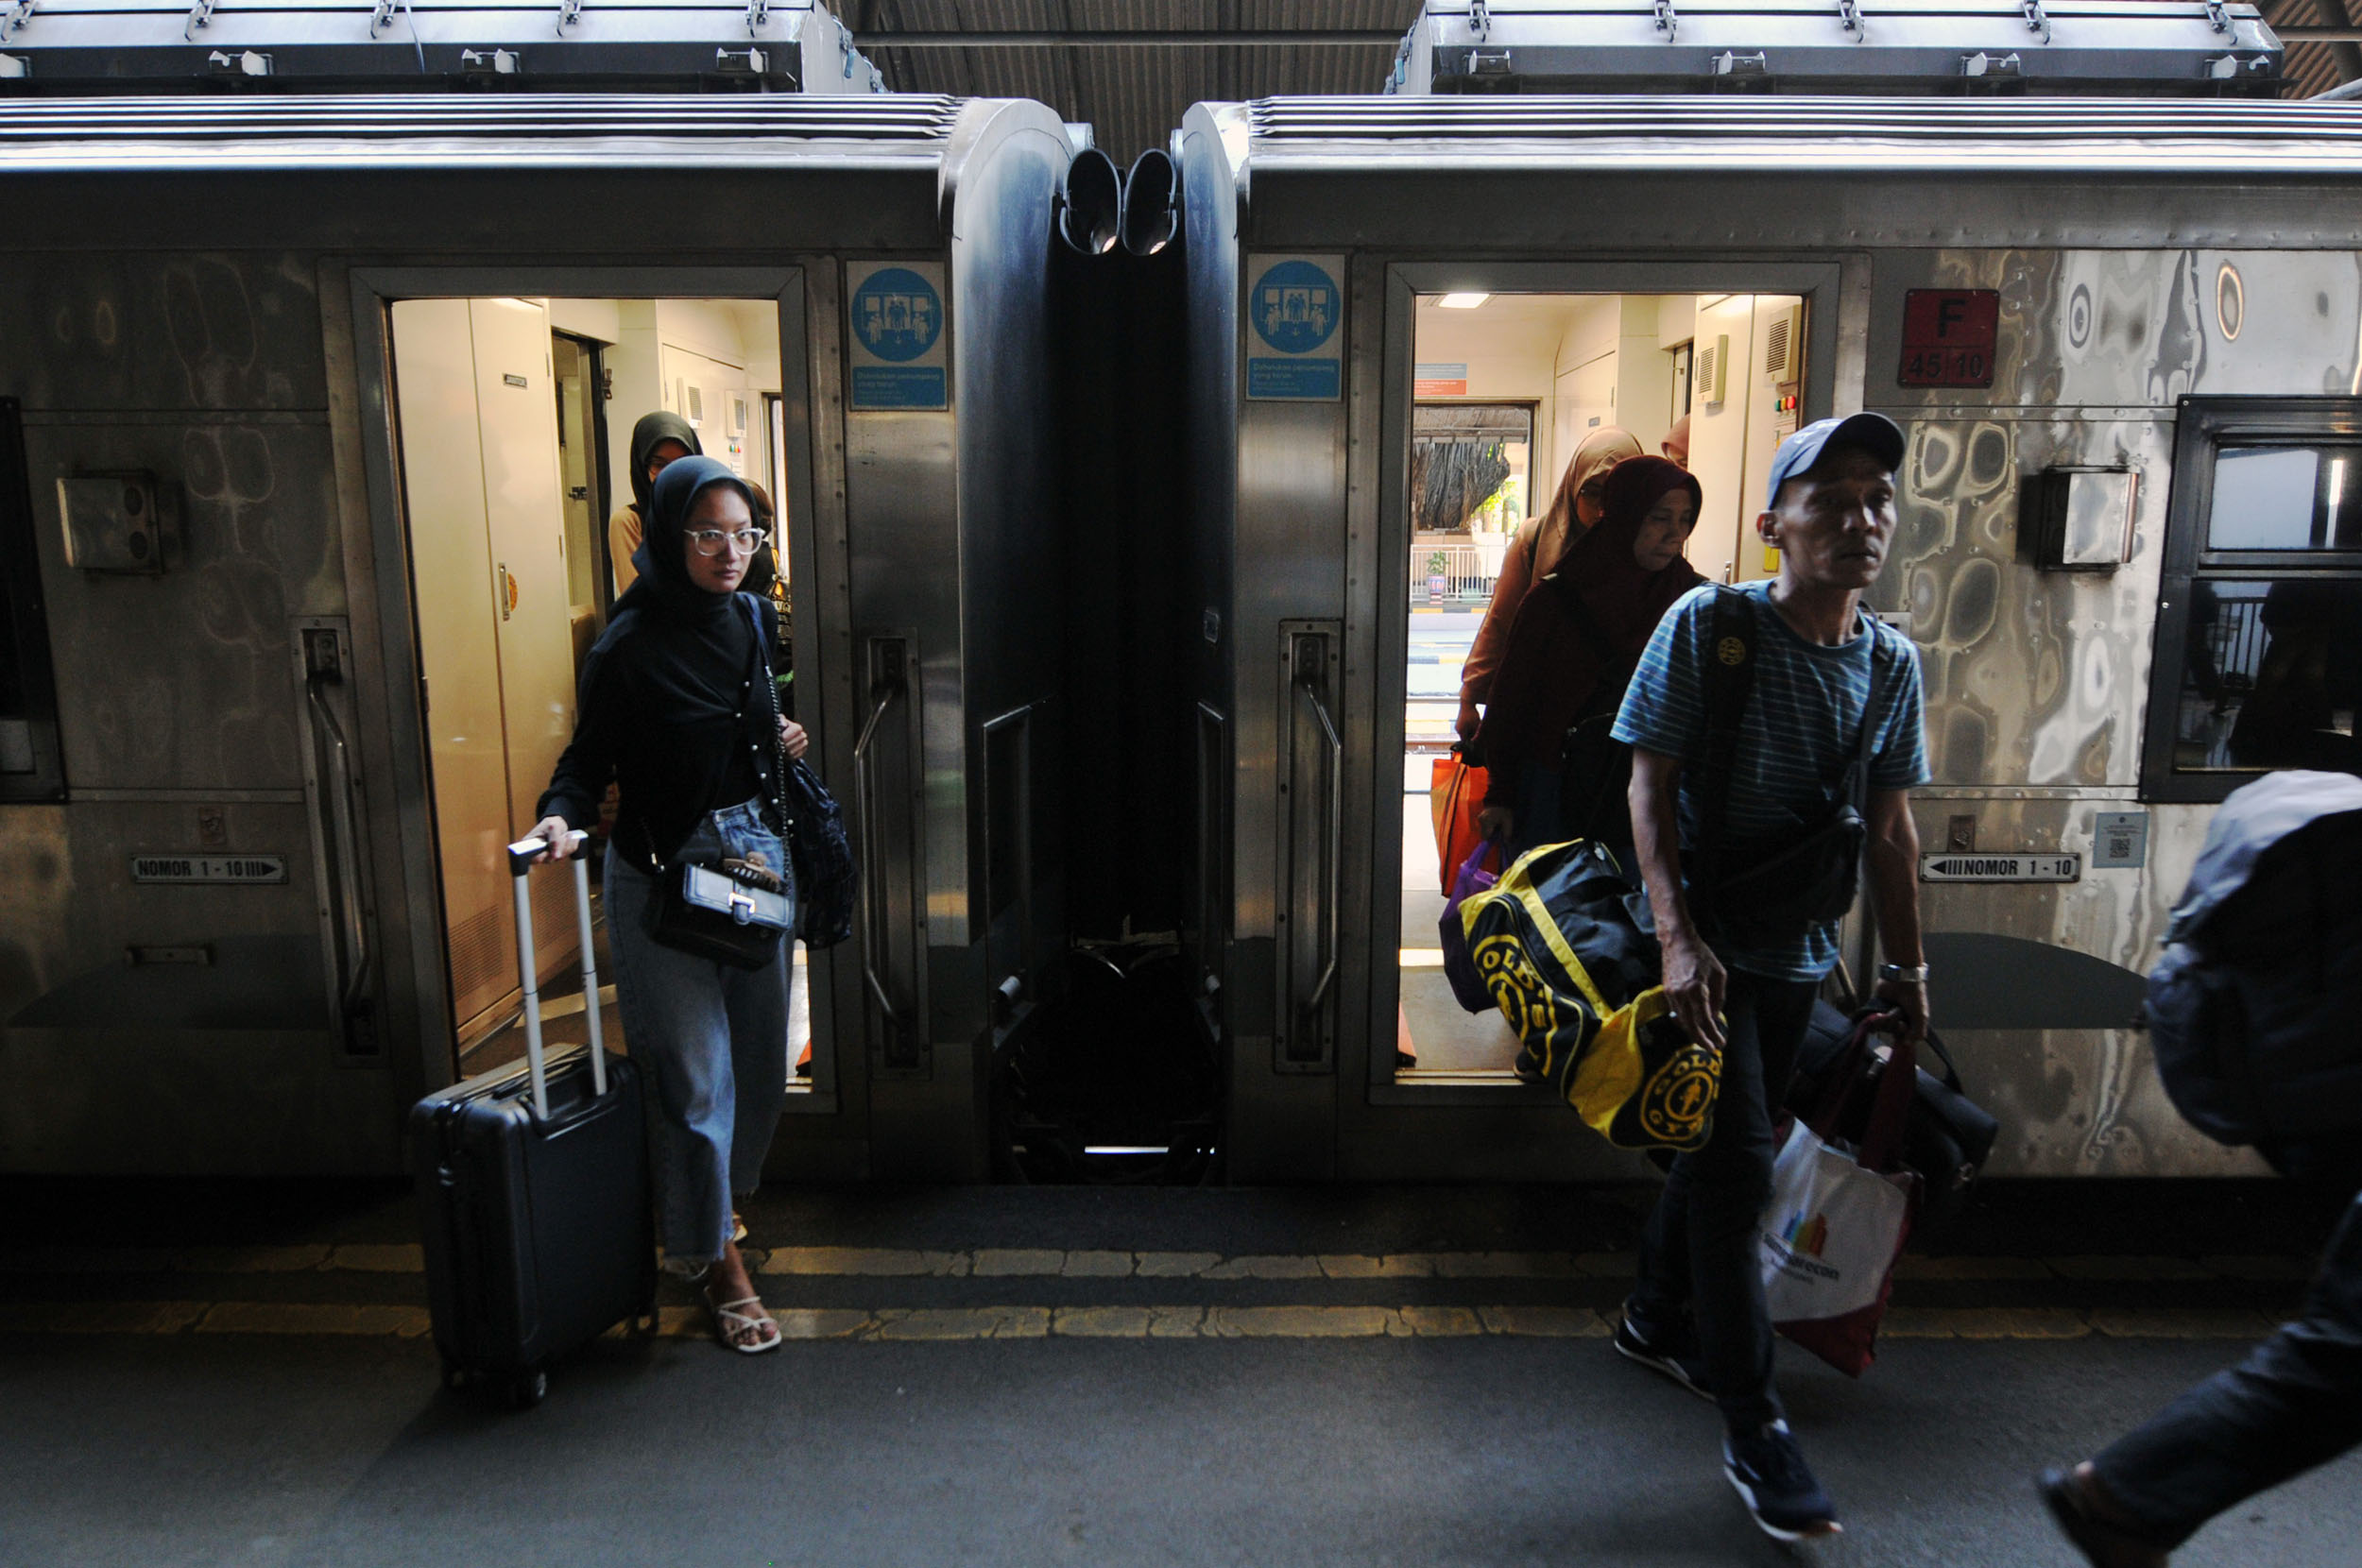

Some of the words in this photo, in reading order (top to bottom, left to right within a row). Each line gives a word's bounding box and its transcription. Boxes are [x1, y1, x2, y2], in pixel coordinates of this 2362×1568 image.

[1938, 298, 1966, 337] F
[1908, 351, 1942, 379] 45
[1957, 352, 1983, 379] 10
[137, 861, 192, 877] NOMOR
[226, 861, 243, 877] 10
[1963, 860, 2018, 876] NOMOR
[2054, 860, 2072, 876] 10
